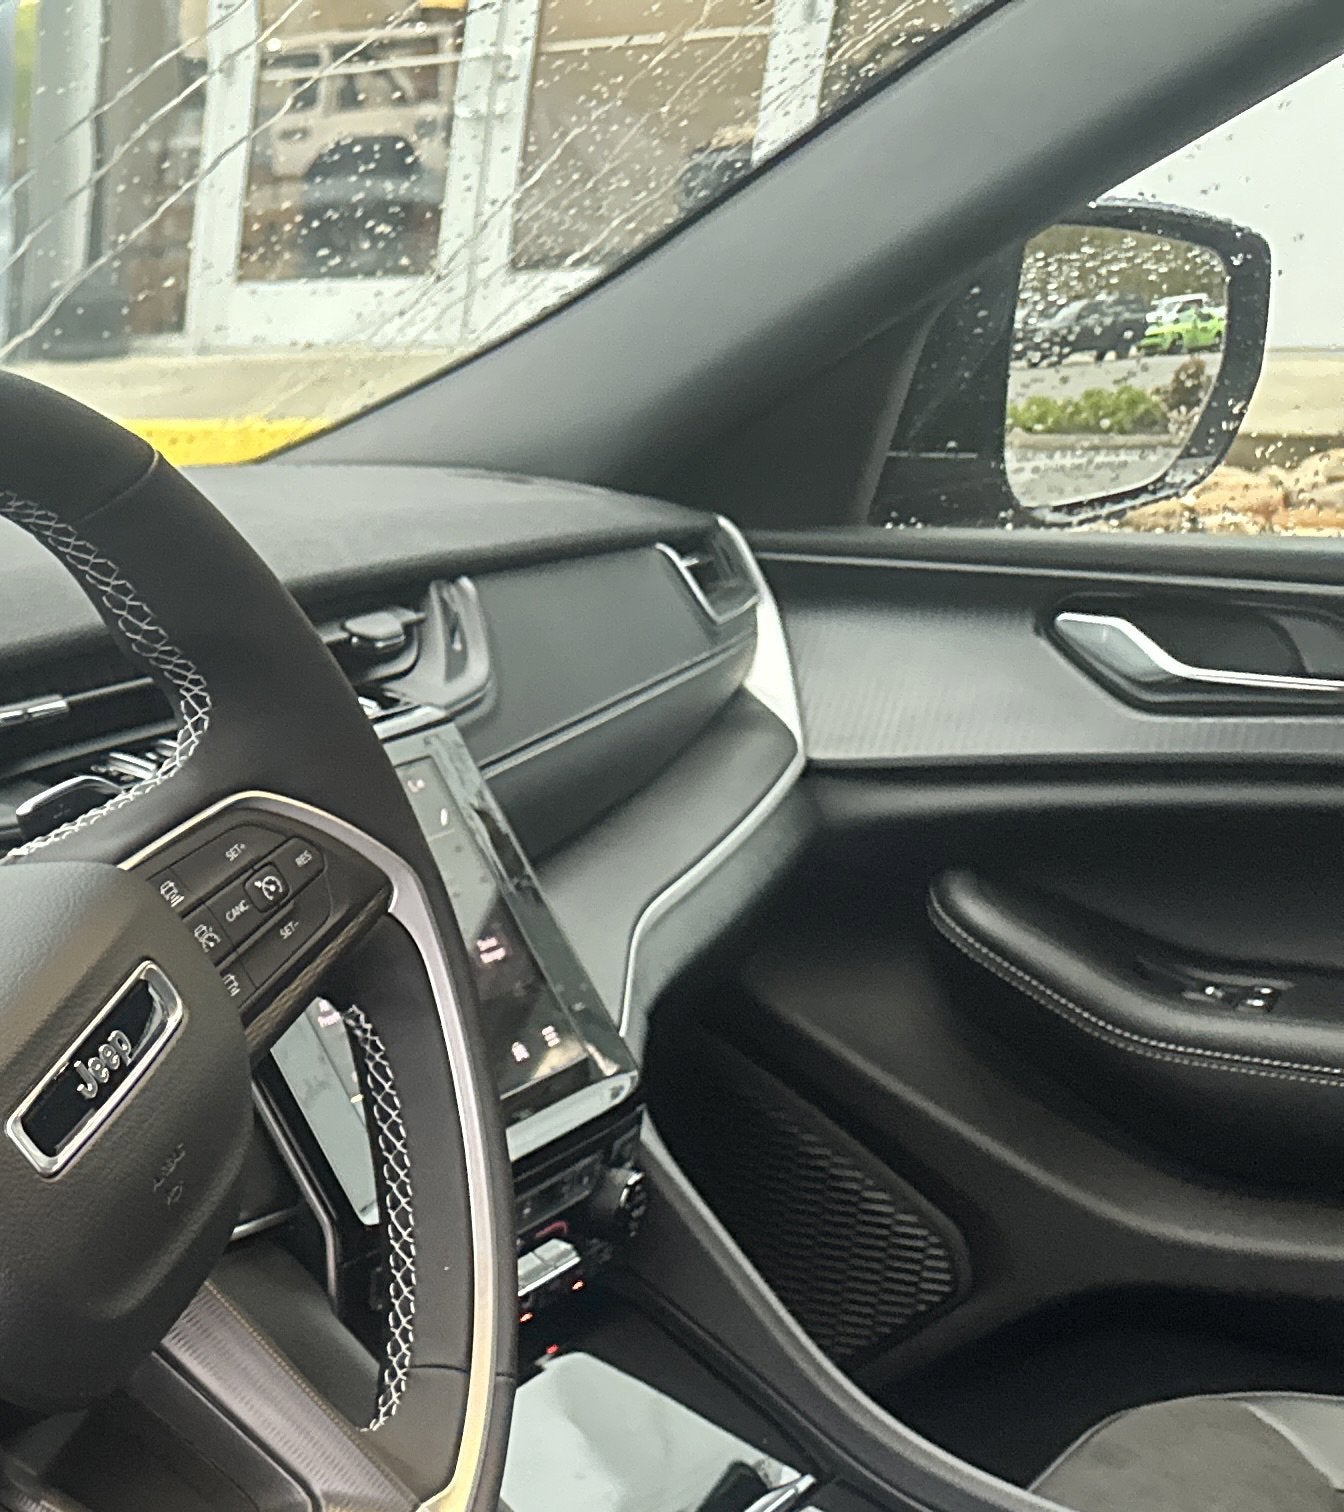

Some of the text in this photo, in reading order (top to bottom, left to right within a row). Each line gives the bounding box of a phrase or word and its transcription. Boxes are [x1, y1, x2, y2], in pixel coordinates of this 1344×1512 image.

[294, 850, 313, 868] RES
[225, 899, 250, 922] CANC
[73, 1030, 132, 1099] Jeep
